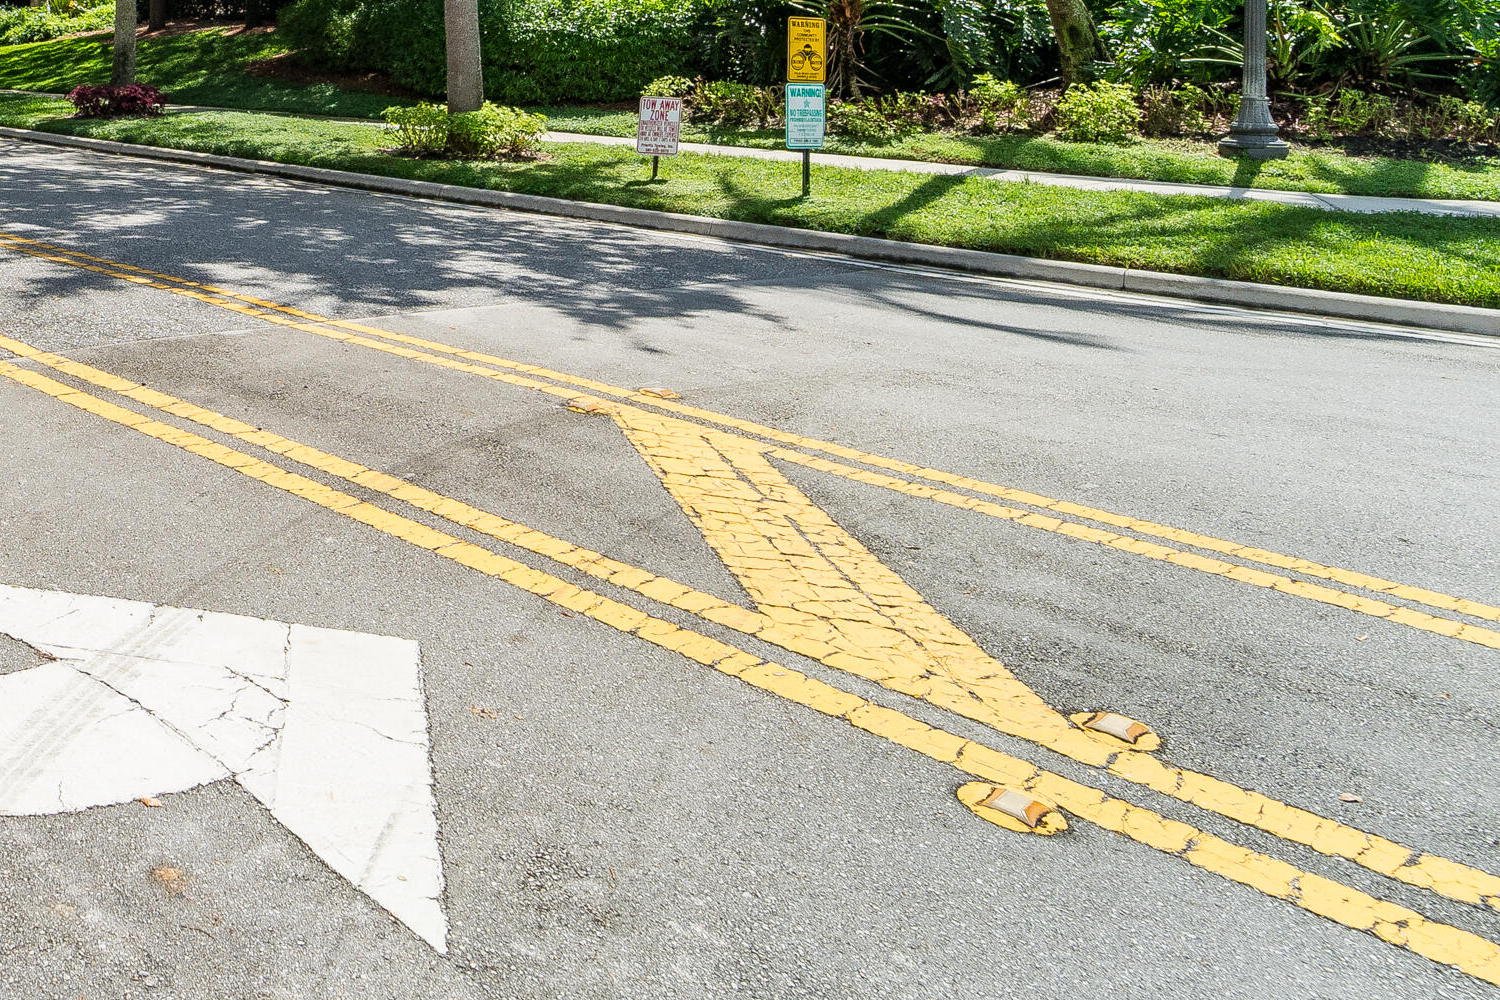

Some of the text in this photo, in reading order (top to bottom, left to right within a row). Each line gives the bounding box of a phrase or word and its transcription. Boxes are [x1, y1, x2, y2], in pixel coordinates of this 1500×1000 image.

[789, 88, 821, 97] WARNING!
[643, 99, 679, 111] TOW AWAY
[650, 110, 669, 121] ZONE
[790, 109, 822, 117] NO TRESPASSING
